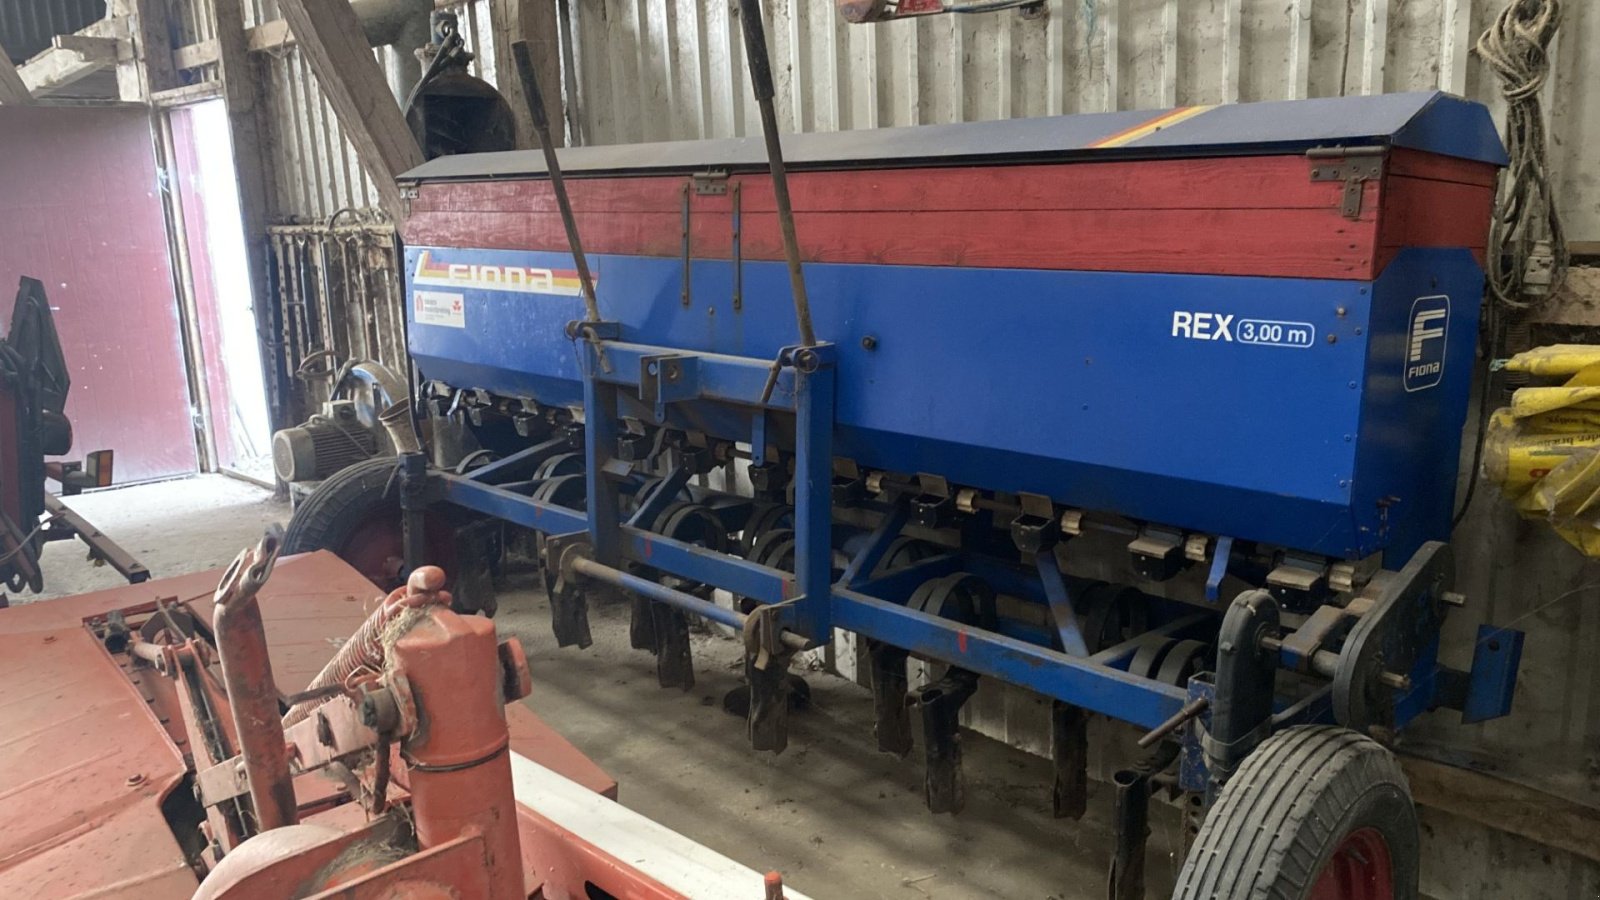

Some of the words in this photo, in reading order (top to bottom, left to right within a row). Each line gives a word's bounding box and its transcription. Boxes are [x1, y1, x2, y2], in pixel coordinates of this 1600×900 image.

[1171, 311, 1234, 341] REX
[1243, 323, 1282, 343] 3,00
[1287, 329, 1307, 343] m
